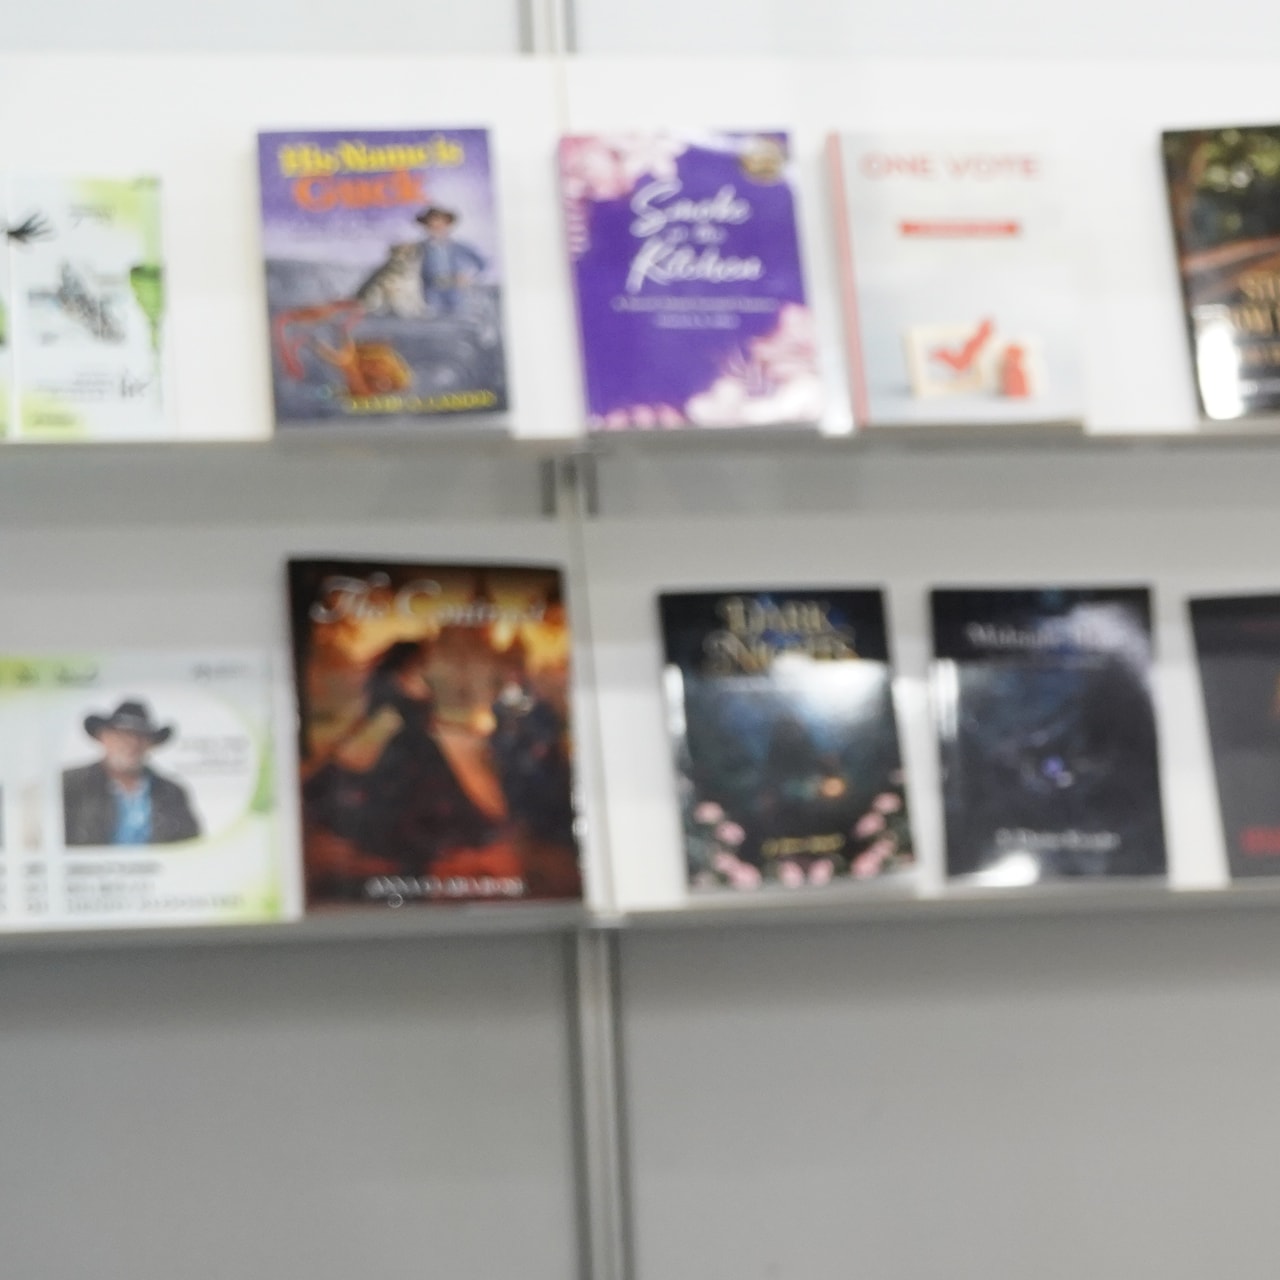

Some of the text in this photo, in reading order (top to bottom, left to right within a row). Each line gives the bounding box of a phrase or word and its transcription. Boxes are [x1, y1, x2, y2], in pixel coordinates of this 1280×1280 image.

[861, 153, 1040, 180] ONE VOTE
[629, 175, 754, 238] Smoke
[625, 234, 766, 294] Kitchen
